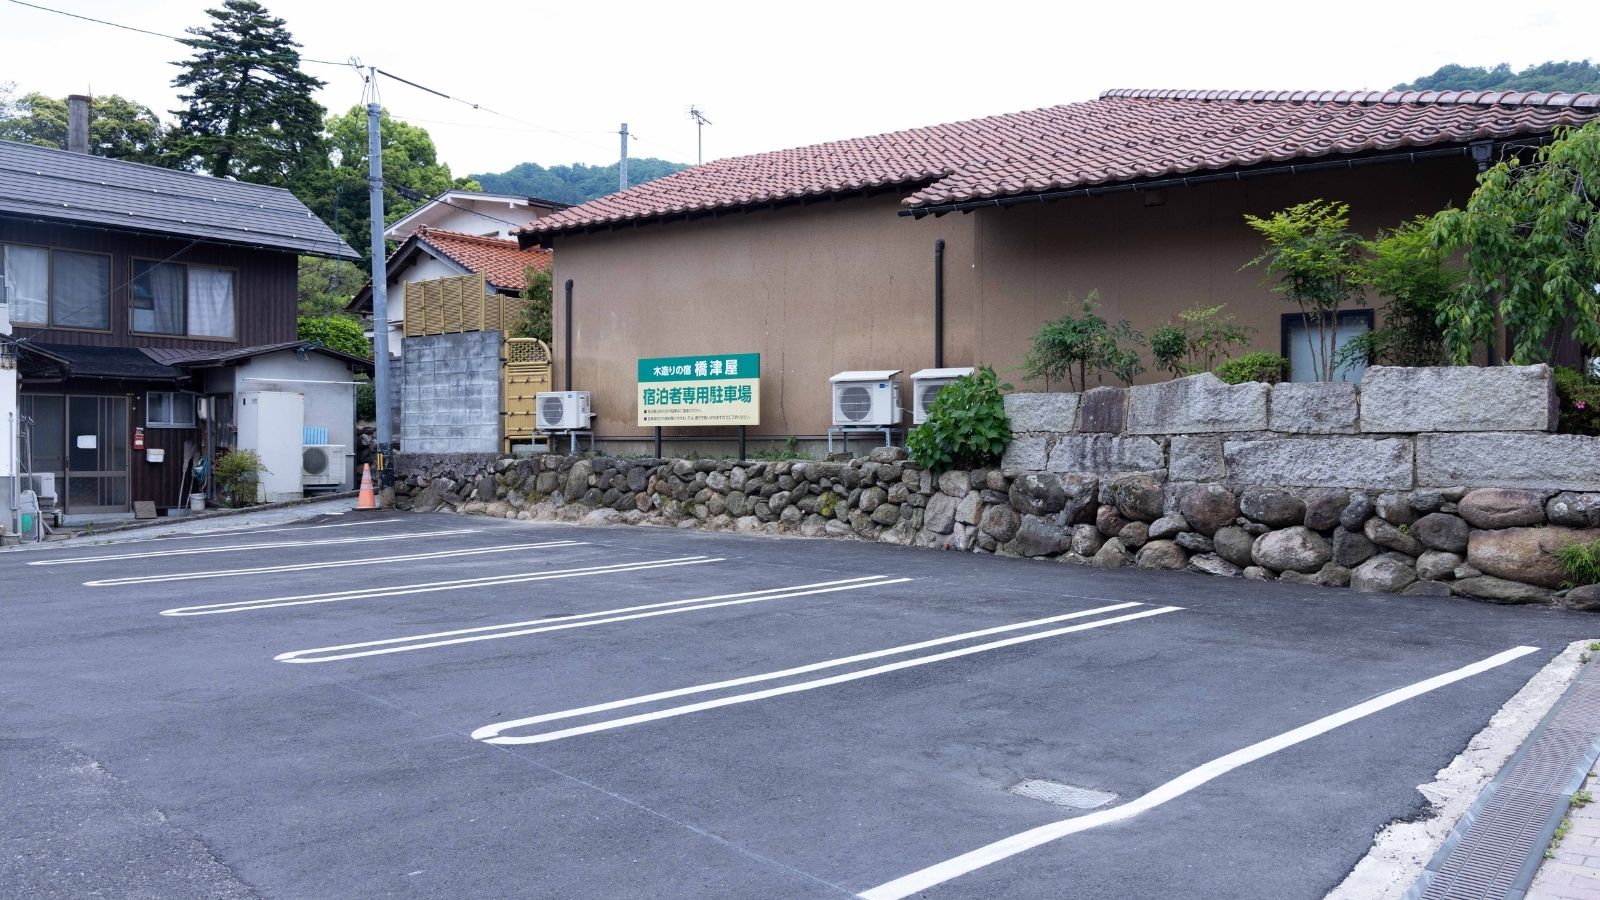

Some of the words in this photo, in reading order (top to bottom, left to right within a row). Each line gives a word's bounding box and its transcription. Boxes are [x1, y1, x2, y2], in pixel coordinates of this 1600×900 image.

[653, 365, 692, 377] 木造りの宿
[694, 359, 738, 377] 橋津屋
[643, 385, 752, 406] 宿泊者専用駐車場
